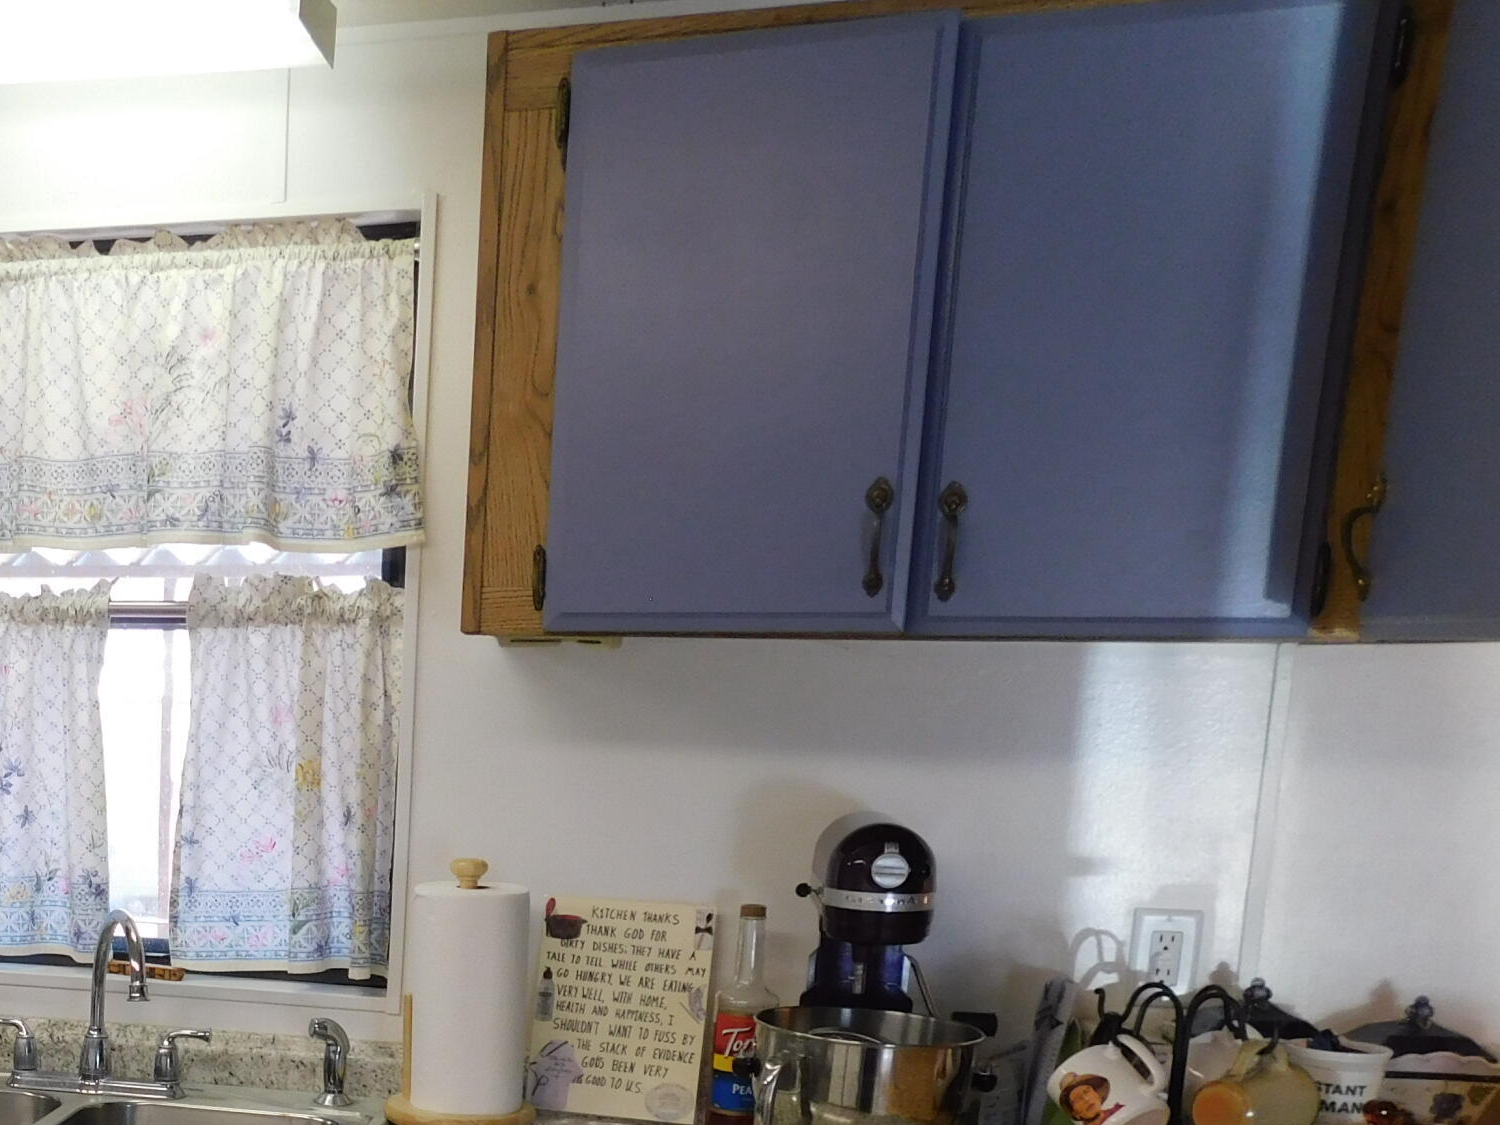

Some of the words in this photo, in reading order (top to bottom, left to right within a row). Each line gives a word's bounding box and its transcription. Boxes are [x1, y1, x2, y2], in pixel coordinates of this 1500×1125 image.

[592, 905, 637, 921] KITCHEN
[643, 911, 680, 926] THANKS
[586, 923, 616, 938] THANK
[624, 927, 644, 940] GOD
[651, 930, 667, 942] FOR
[632, 944, 651, 957] THEY
[658, 946, 682, 960] HAVE
[689, 951, 696, 961] A
[546, 951, 566, 962] TALE
[571, 954, 581, 965] TO
[585, 955, 603, 968] TELL
[611, 959, 637, 972] WHILE
[644, 962, 677, 975] OTHERS
[685, 967, 706, 978] MAY
[556, 967, 569, 978] GO
[619, 975, 631, 987] WE
[638, 976, 655, 990] ARE
[662, 979, 694, 994] EATING
[557, 984, 579, 997] VERY
[612, 990, 633, 1004] WITH
[639, 994, 667, 1010] HOME,
[555, 1000, 585, 1014] HEALTH
[591, 1004, 609, 1017] AND
[615, 1008, 663, 1026] HAPPINESS,
[668, 1014, 674, 1026] I
[608, 1024, 633, 1039] WANT
[639, 1027, 650, 1040] TO
[653, 1030, 677, 1044] FUSS
[682, 1034, 695, 1046] BY
[576, 1038, 592, 1051] THE
[599, 1041, 628, 1056] STACK
[635, 1046, 646, 1057] OF
[652, 1048, 695, 1065] EVIDENCE
[611, 1059, 636, 1073] BEEN
[643, 1063, 669, 1079] VERY
[585, 1074, 606, 1087] GOOD
[610, 1076, 621, 1090] TO
